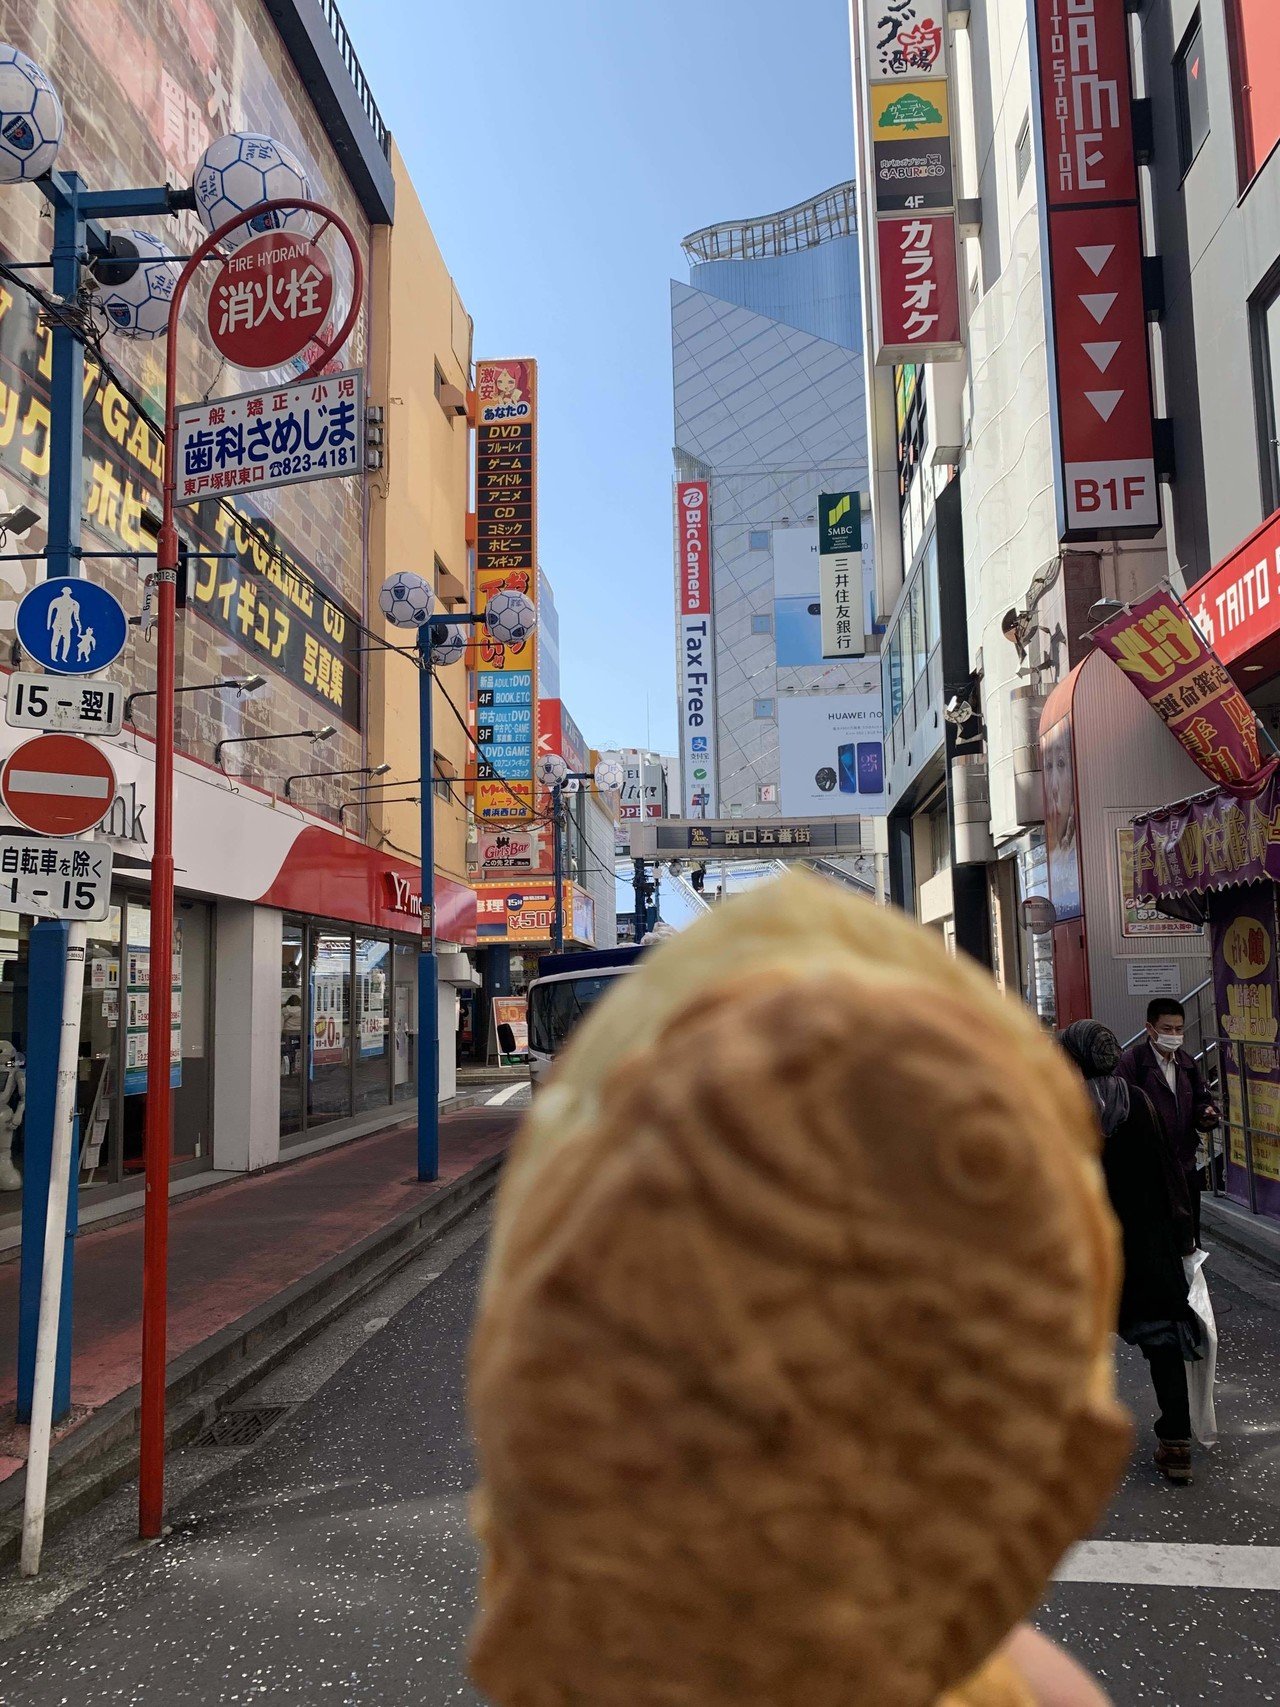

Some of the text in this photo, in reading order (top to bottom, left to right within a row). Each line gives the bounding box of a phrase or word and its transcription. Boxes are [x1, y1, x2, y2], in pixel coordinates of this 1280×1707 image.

[1052, 59, 1073, 191] STATION
[258, 142, 273, 160] 5th
[904, 196, 924, 209] 4F
[228, 242, 311, 275] FIRE HYDRANT
[151, 275, 166, 292] 5th
[900, 221, 939, 339] カラオケ
[218, 264, 324, 334] 消火栓
[480, 368, 495, 400] 激安
[483, 402, 528, 421] あなたの
[184, 400, 355, 475] 歯科さめじま
[489, 426, 521, 439] DVD
[487, 442, 522, 454] ブルーレイ
[183, 445, 356, 496] 東戸塚駅東口 823-4181
[488, 458, 522, 470] ゲーム
[487, 474, 522, 486] アイドル
[488, 490, 522, 502] アニメ
[1074, 475, 1146, 514] B1F
[494, 507, 516, 518] CD
[487, 522, 523, 535] コミック
[828, 526, 852, 535] SMBC
[488, 539, 522, 551] ホビー
[487, 555, 523, 568] フィギュア
[685, 509, 702, 610] BicCamera
[835, 558, 851, 649] 三井住友銀行
[1215, 558, 1270, 637] TAITO
[195, 541, 344, 707] フィギュア 写真集
[686, 620, 708, 727] Tax Free
[479, 693, 492, 704] 4F
[1150, 664, 1230, 723] 運命鑑定
[828, 712, 866, 720] HUAWEI
[479, 729, 491, 740] 3F
[691, 828, 704, 836] 5th
[725, 828, 810, 845] 西口五番街
[510, 842, 529, 856] Bar
[1, 845, 102, 880] 自転車を除く
[509, 911, 567, 929] ¥50
